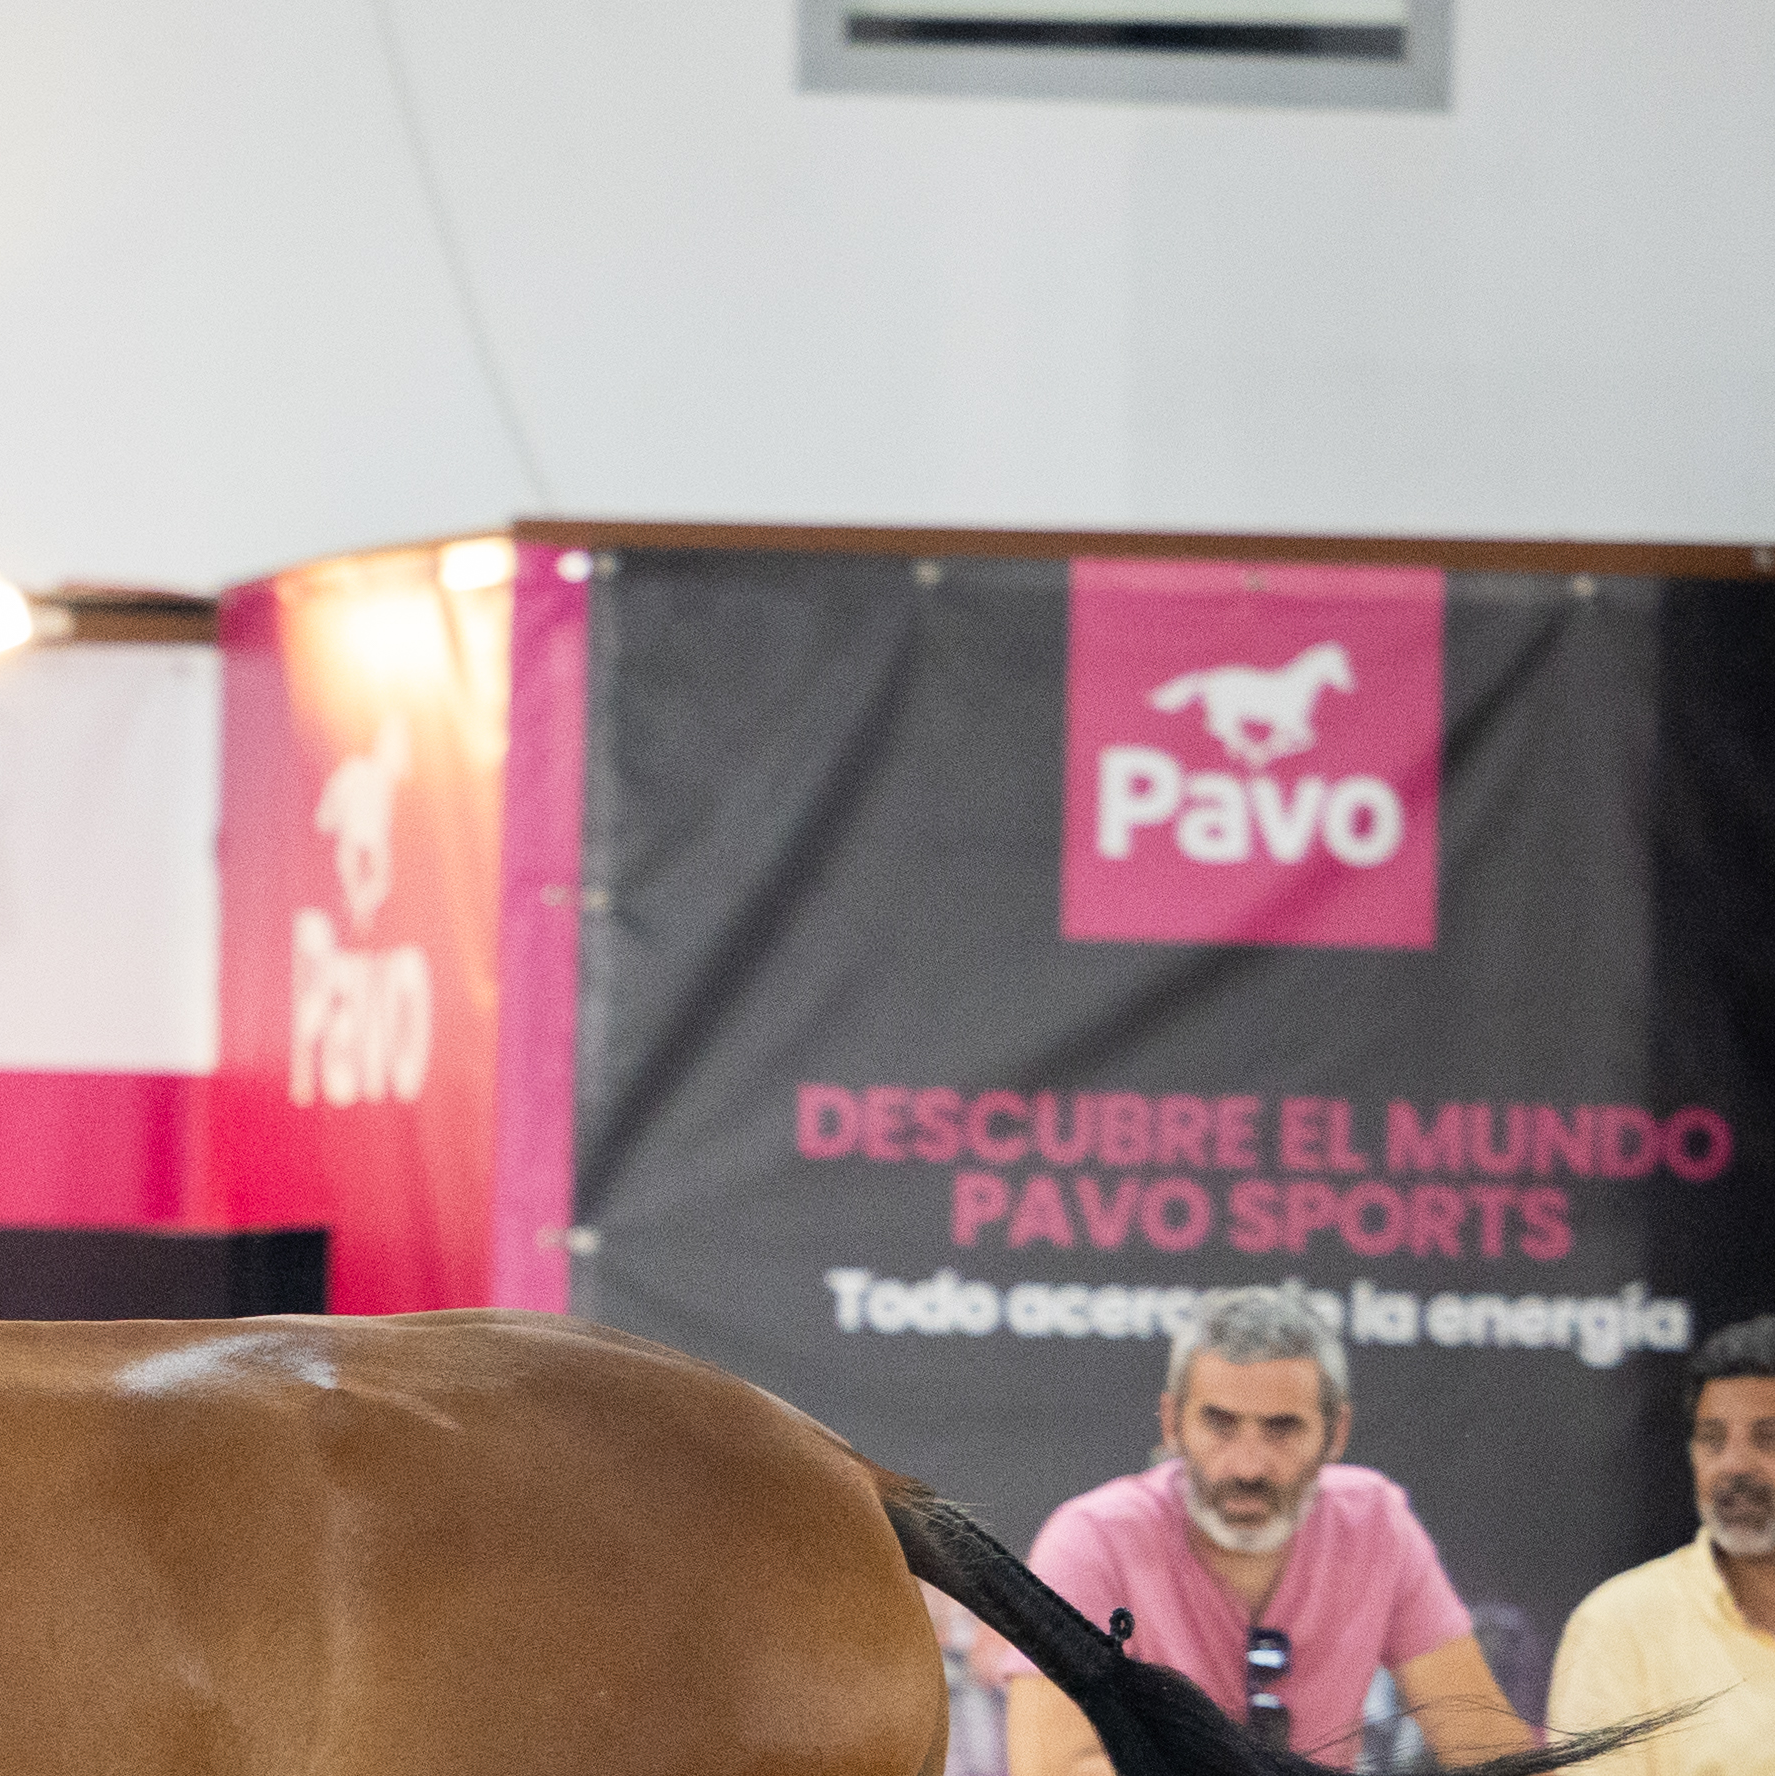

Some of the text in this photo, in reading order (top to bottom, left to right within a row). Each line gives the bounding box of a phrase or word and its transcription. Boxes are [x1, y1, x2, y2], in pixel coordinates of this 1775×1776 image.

[1095, 744, 1404, 867] Pavo
[795, 1082, 1734, 1183] DESCUBRE EL MUNDO
[951, 1172, 1573, 1261] PAVO SPORTS
[823, 1265, 1005, 1336] Todo
[1005, 1280, 1211, 1341] acerc
[1349, 1276, 1423, 1346] la
[1423, 1278, 1693, 1369] energía
